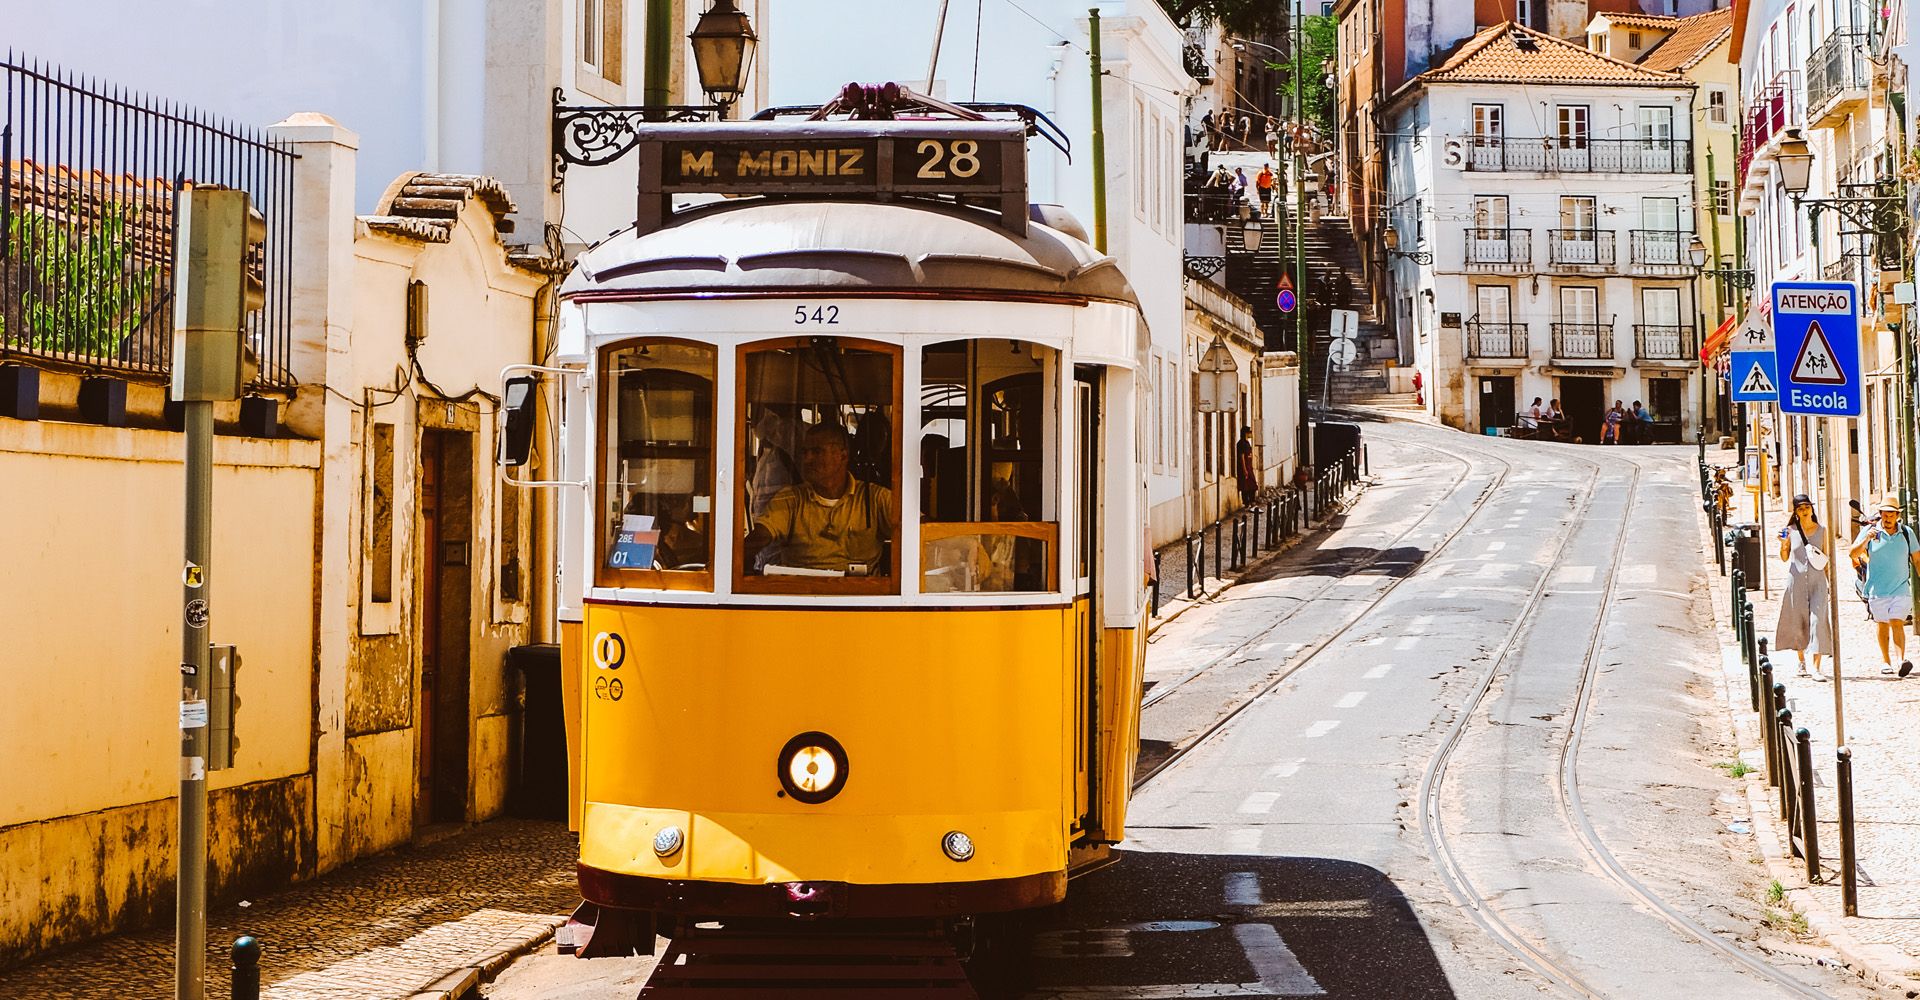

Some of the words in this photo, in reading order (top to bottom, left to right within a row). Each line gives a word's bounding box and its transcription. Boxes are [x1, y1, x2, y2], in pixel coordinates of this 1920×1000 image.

[681, 150, 718, 177] M.
[737, 148, 865, 177] MONIZ
[916, 140, 981, 179] 28
[1780, 293, 1848, 312] ATENÇÃO
[794, 305, 840, 325] 542
[1791, 389, 1848, 410] Escola
[617, 533, 634, 543] 28E
[613, 551, 628, 565] 01
